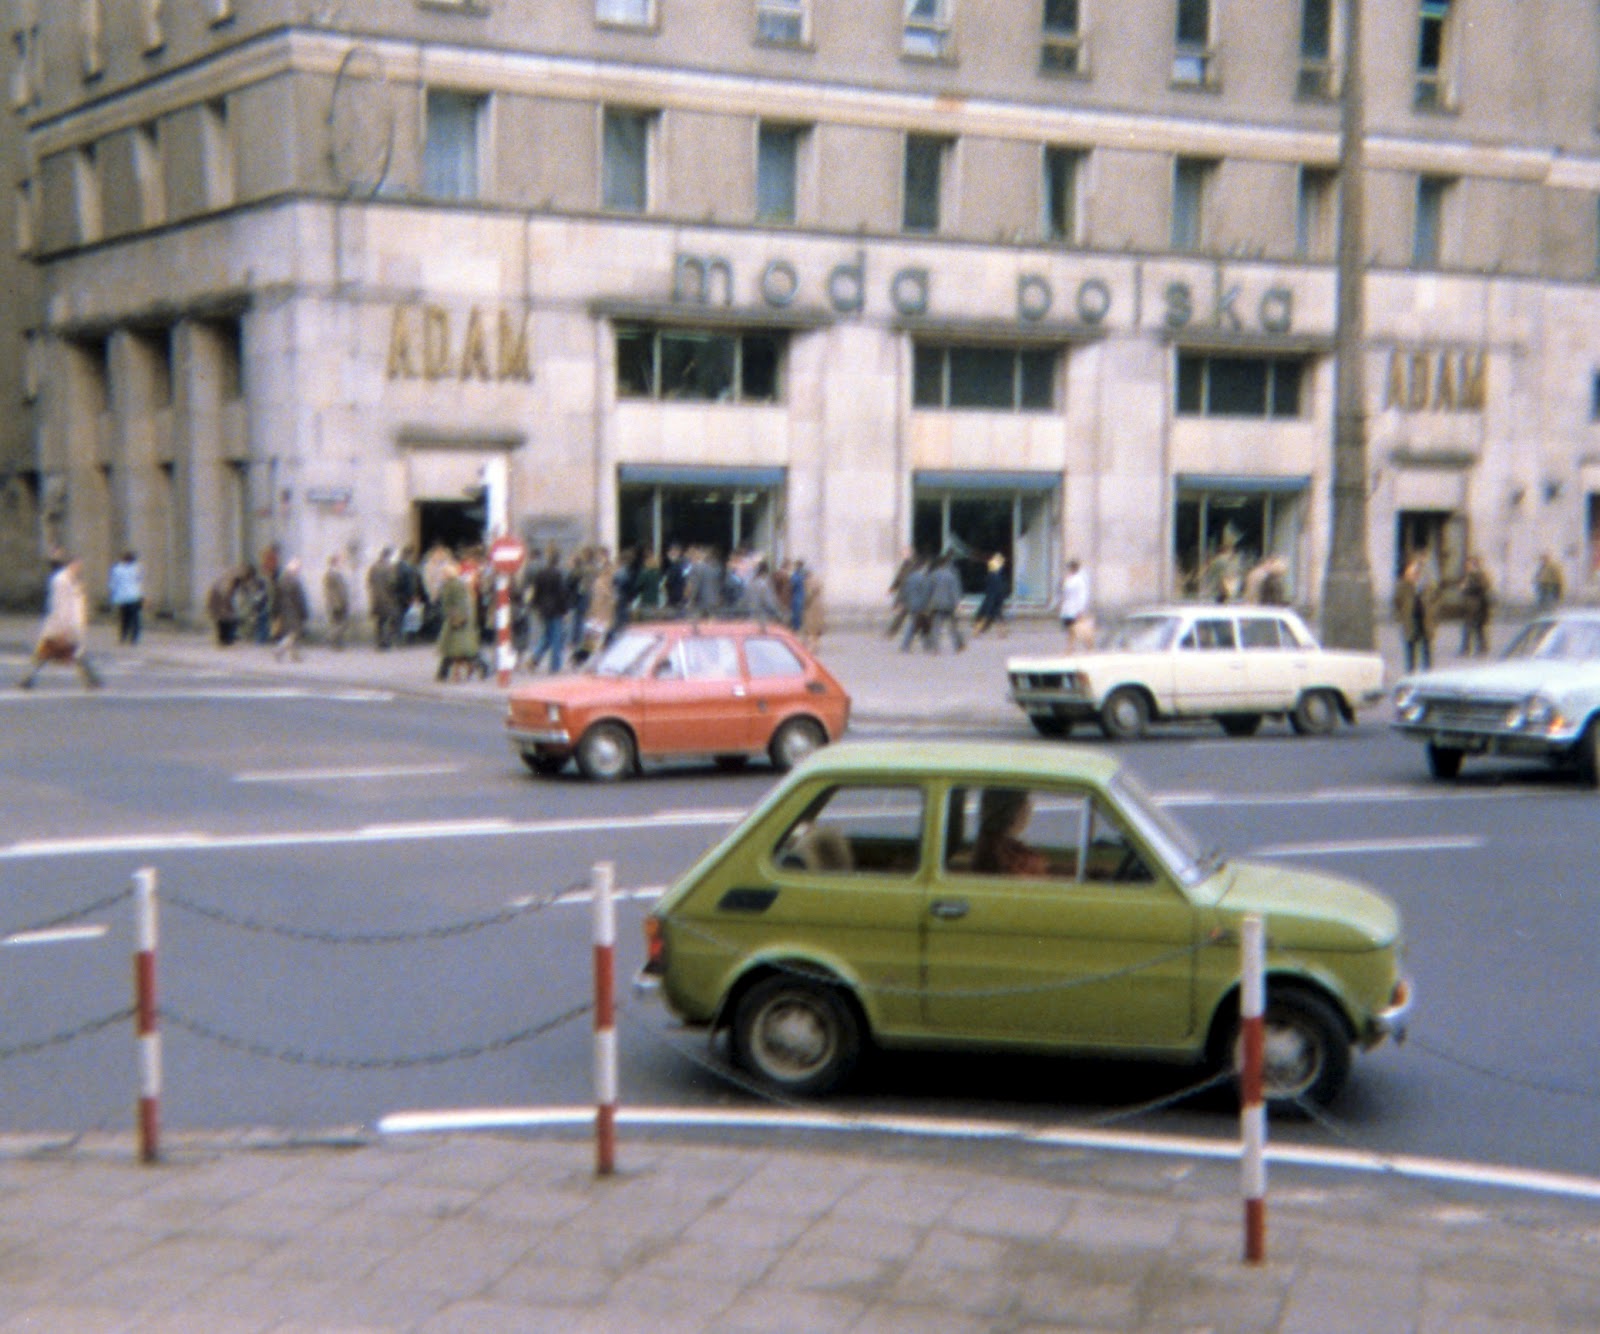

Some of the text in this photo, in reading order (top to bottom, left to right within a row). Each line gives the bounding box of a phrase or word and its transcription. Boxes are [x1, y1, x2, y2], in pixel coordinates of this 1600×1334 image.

[674, 250, 1293, 334] moda polska
[387, 304, 533, 382] ADAM
[1383, 348, 1487, 412] ADAM
